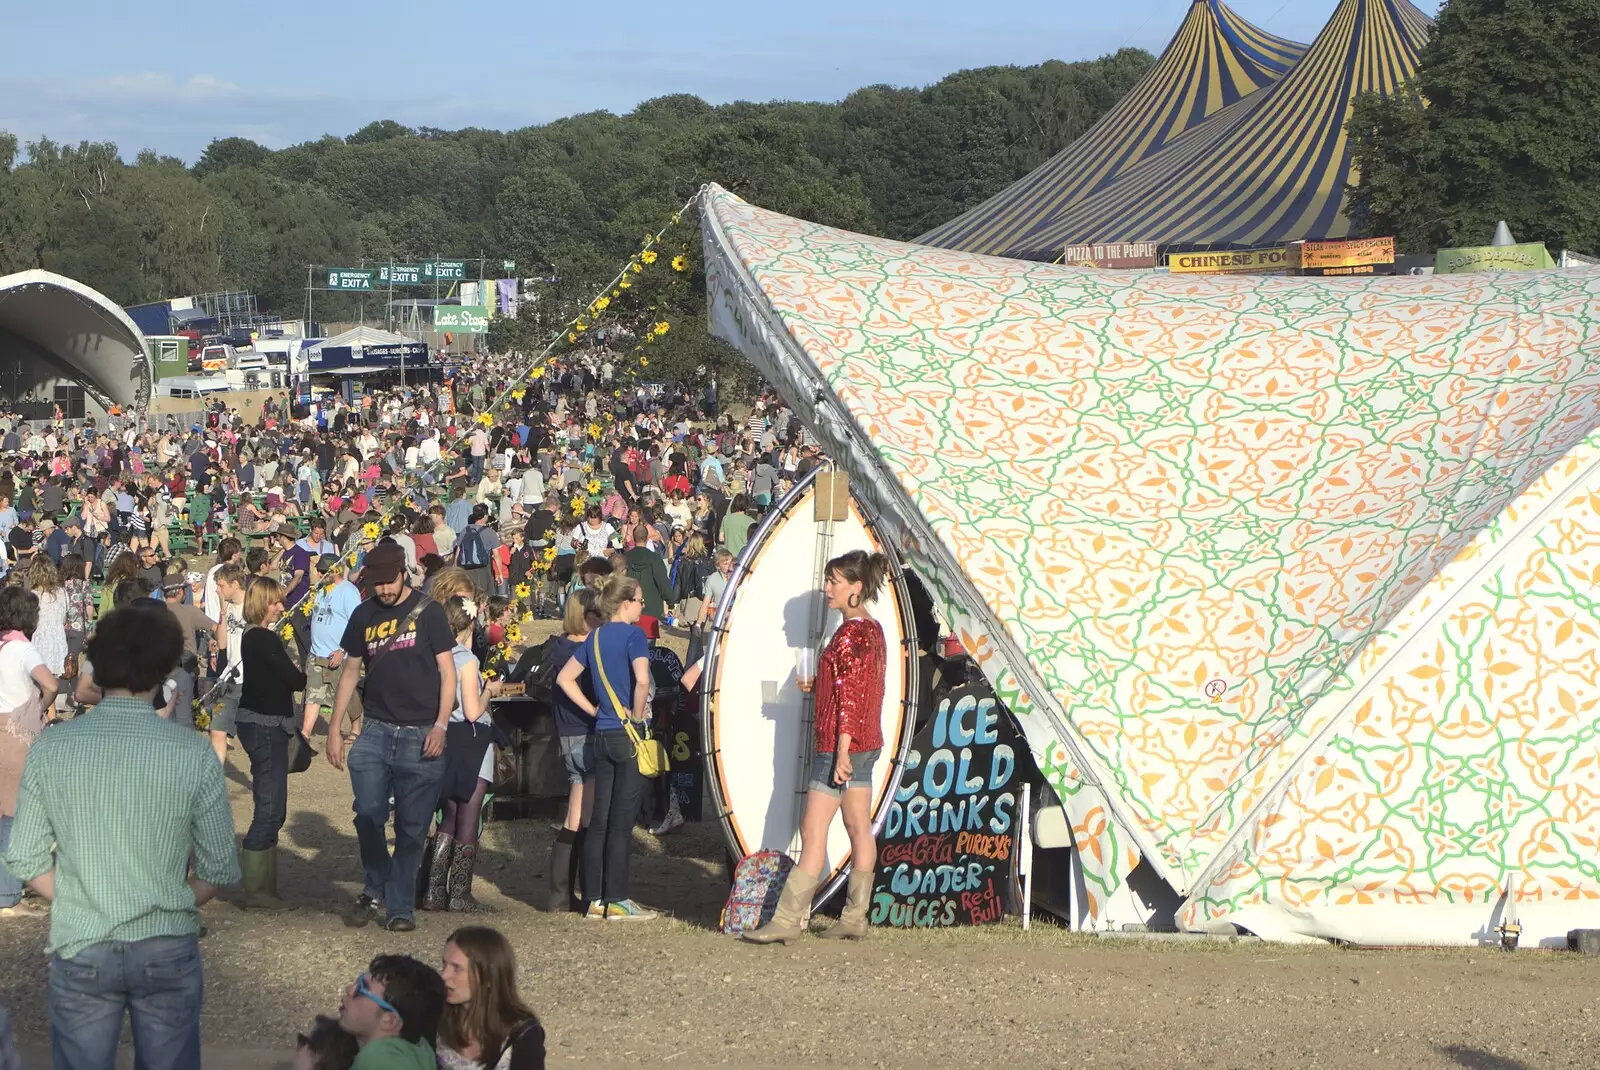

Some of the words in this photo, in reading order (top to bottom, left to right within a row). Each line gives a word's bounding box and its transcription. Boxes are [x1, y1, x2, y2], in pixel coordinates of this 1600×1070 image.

[1067, 247, 1092, 261] PIZZA
[1093, 246, 1104, 260] TO
[1106, 245, 1121, 259] THE
[1123, 243, 1154, 258] PEOPLE
[1306, 243, 1324, 251] STEAK
[1365, 238, 1392, 248] CHICKEN
[1179, 254, 1253, 268] CHINESE
[1448, 253, 1481, 271] SOFT
[1484, 251, 1536, 266] DRINKS
[391, 273, 410, 282] EXIT
[411, 273, 418, 282] B
[436, 269, 454, 277] EXIT
[455, 269, 462, 277] C
[341, 279, 361, 288] EXIT
[362, 280, 370, 288] A
[434, 309, 459, 326] Lake
[932, 695, 999, 748] ICE
[894, 744, 1015, 802] COLD
[890, 862, 984, 896] WATER
[961, 878, 995, 912] Red
[970, 896, 1002, 925] Bull
